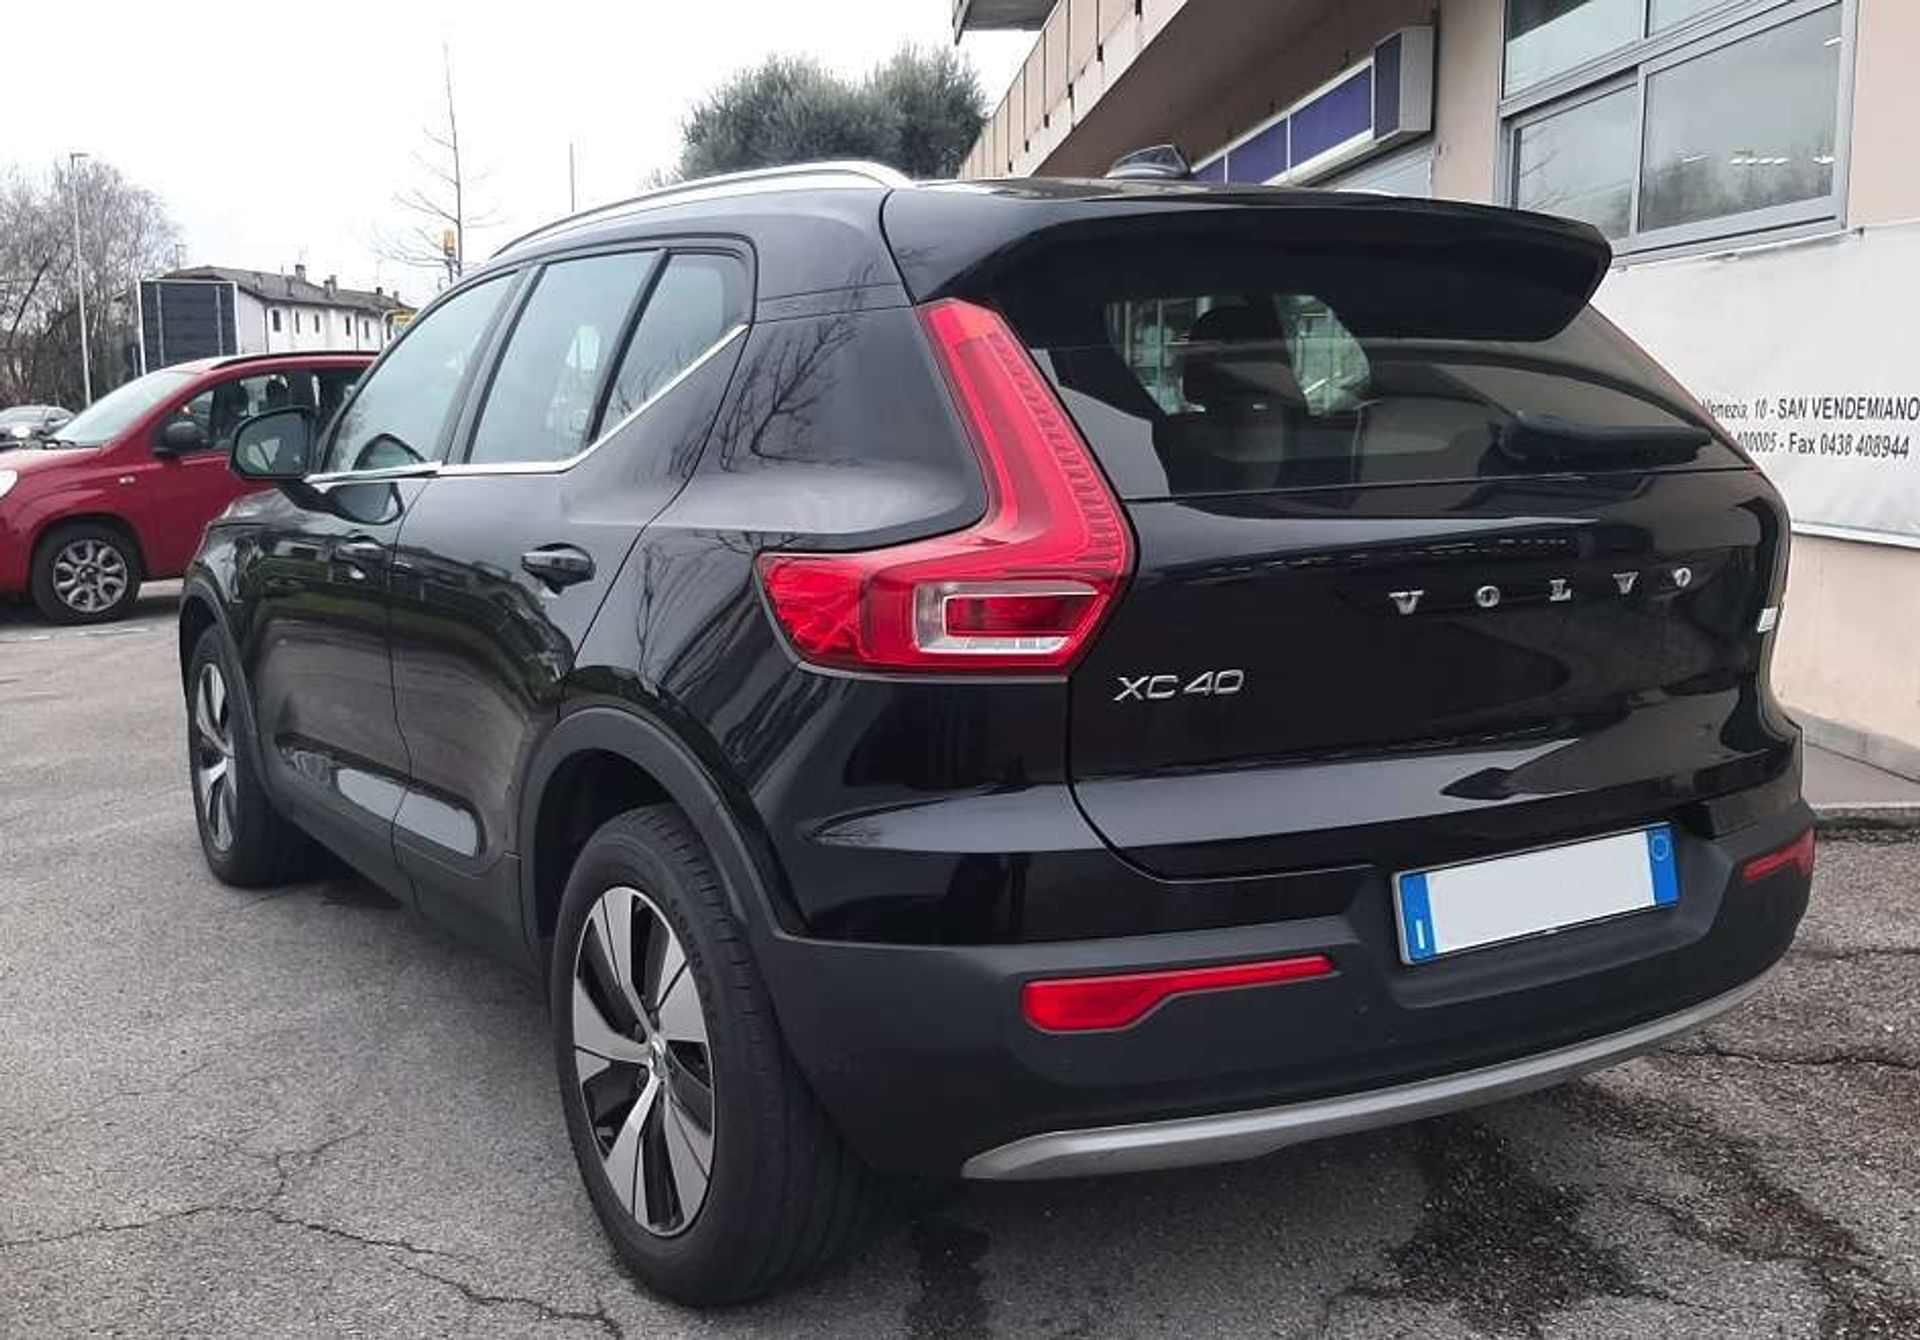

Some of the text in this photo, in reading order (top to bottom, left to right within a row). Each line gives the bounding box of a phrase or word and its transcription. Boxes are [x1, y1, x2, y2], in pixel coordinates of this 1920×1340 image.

[1778, 398, 1807, 420] SAN
[1812, 397, 1920, 420] VENDEMIANO
[1788, 432, 1815, 454] Fax
[1820, 433, 1852, 455] 0438
[1855, 434, 1908, 459] 408944
[1389, 567, 1691, 614] VOLVO
